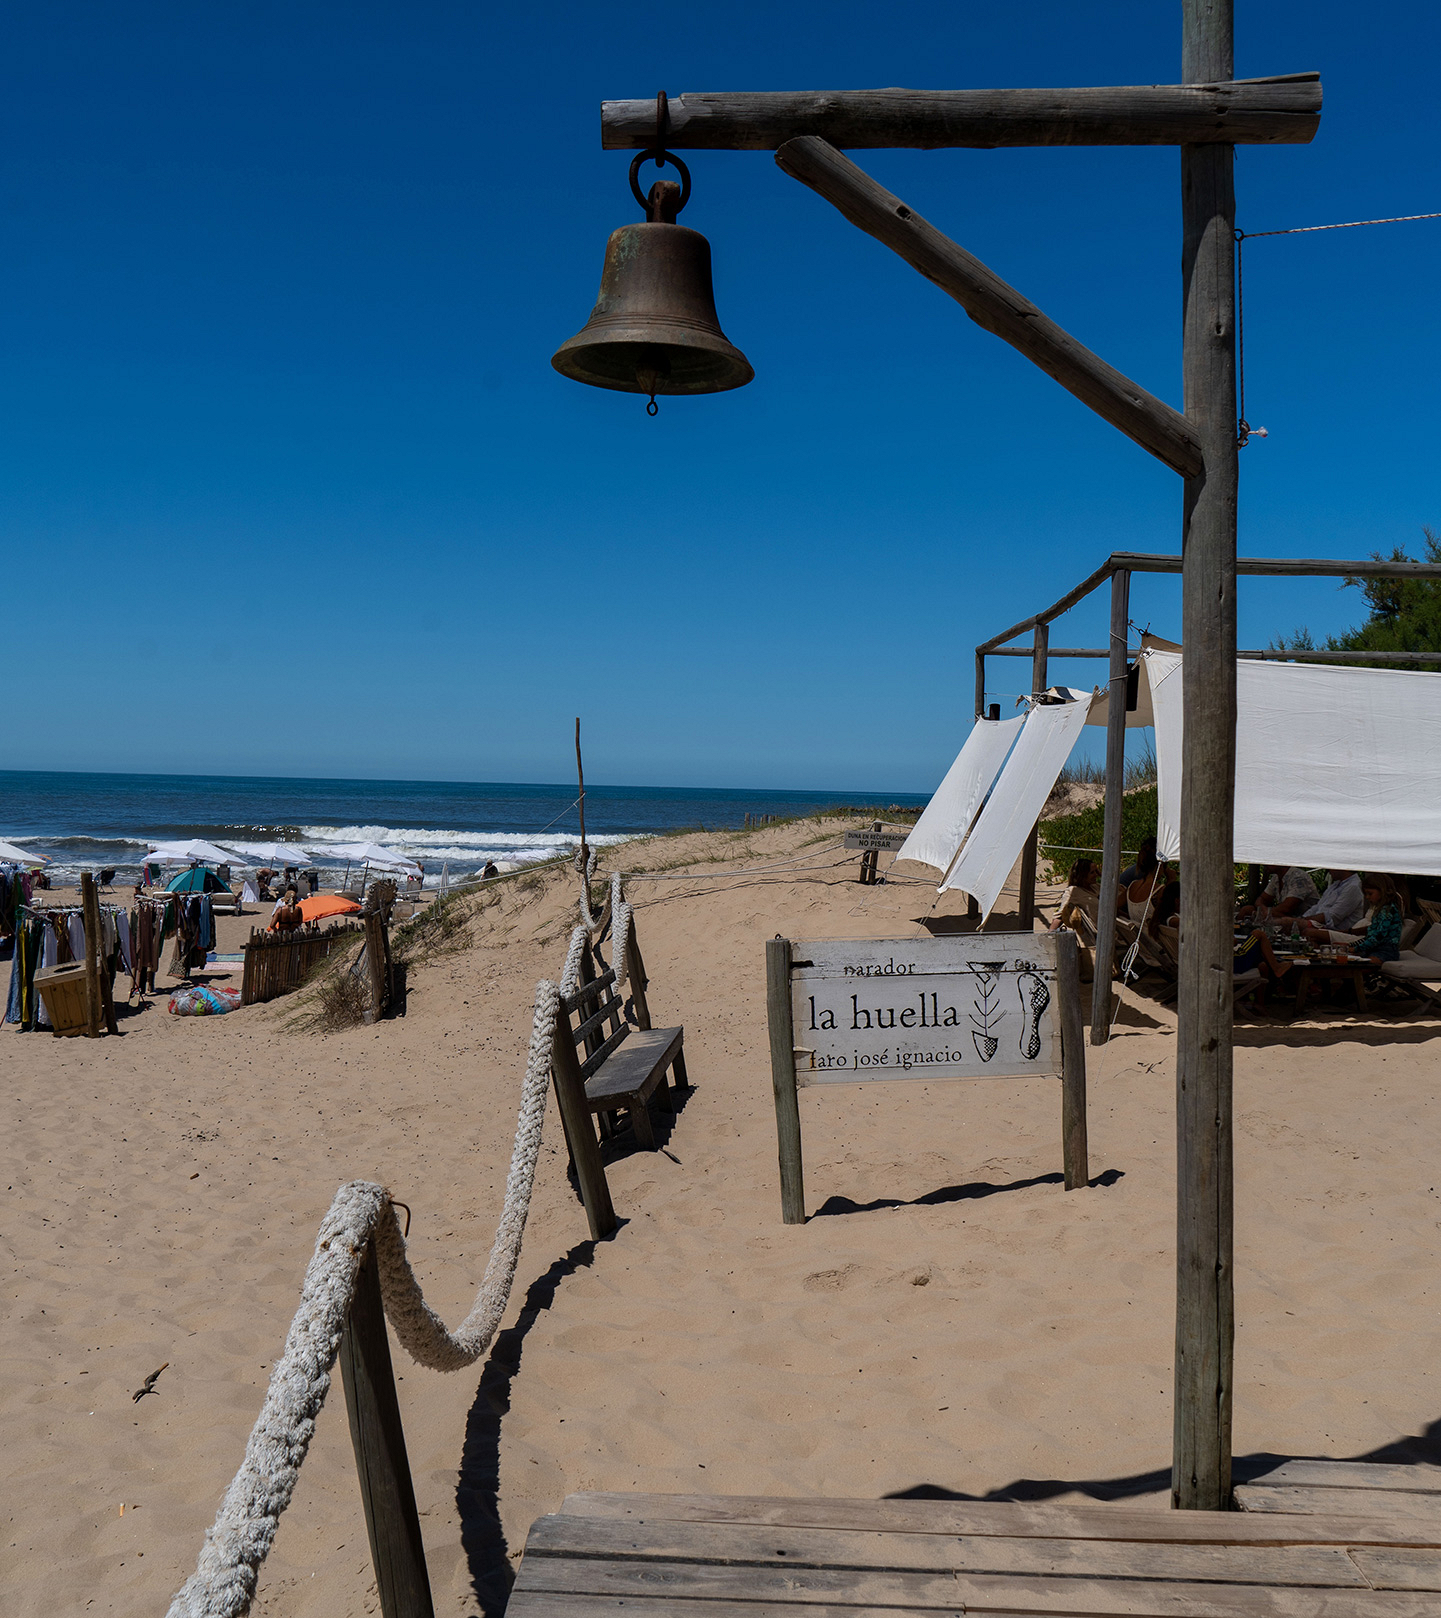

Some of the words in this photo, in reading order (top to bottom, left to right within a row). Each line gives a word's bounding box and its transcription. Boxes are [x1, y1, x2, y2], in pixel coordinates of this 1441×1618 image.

[808, 995, 838, 1031] la
[850, 992, 960, 1030] huella
[810, 1050, 847, 1068] faro
[854, 1048, 888, 1071] josé
[896, 1045, 962, 1070] ignacio
